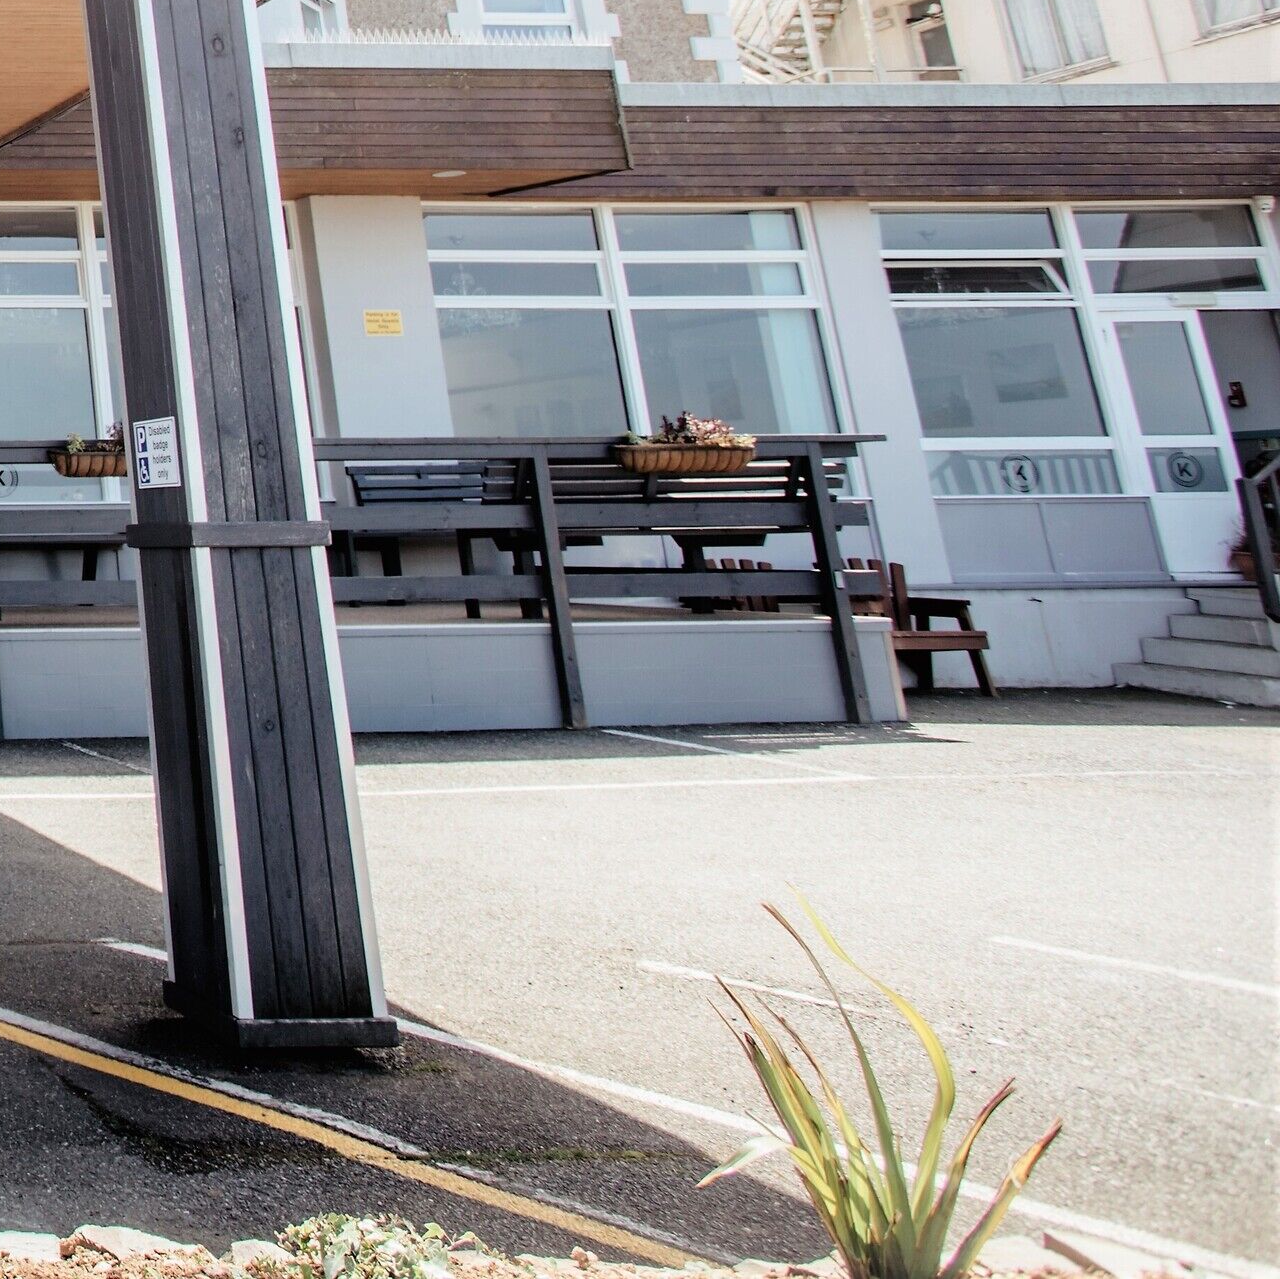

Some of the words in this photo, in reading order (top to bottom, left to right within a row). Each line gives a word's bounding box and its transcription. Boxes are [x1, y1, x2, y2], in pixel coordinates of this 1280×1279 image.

[148, 425, 171, 436] Disabled
[152, 441, 169, 452] badge
[152, 454, 172, 465] holders
[158, 468, 169, 480] only
